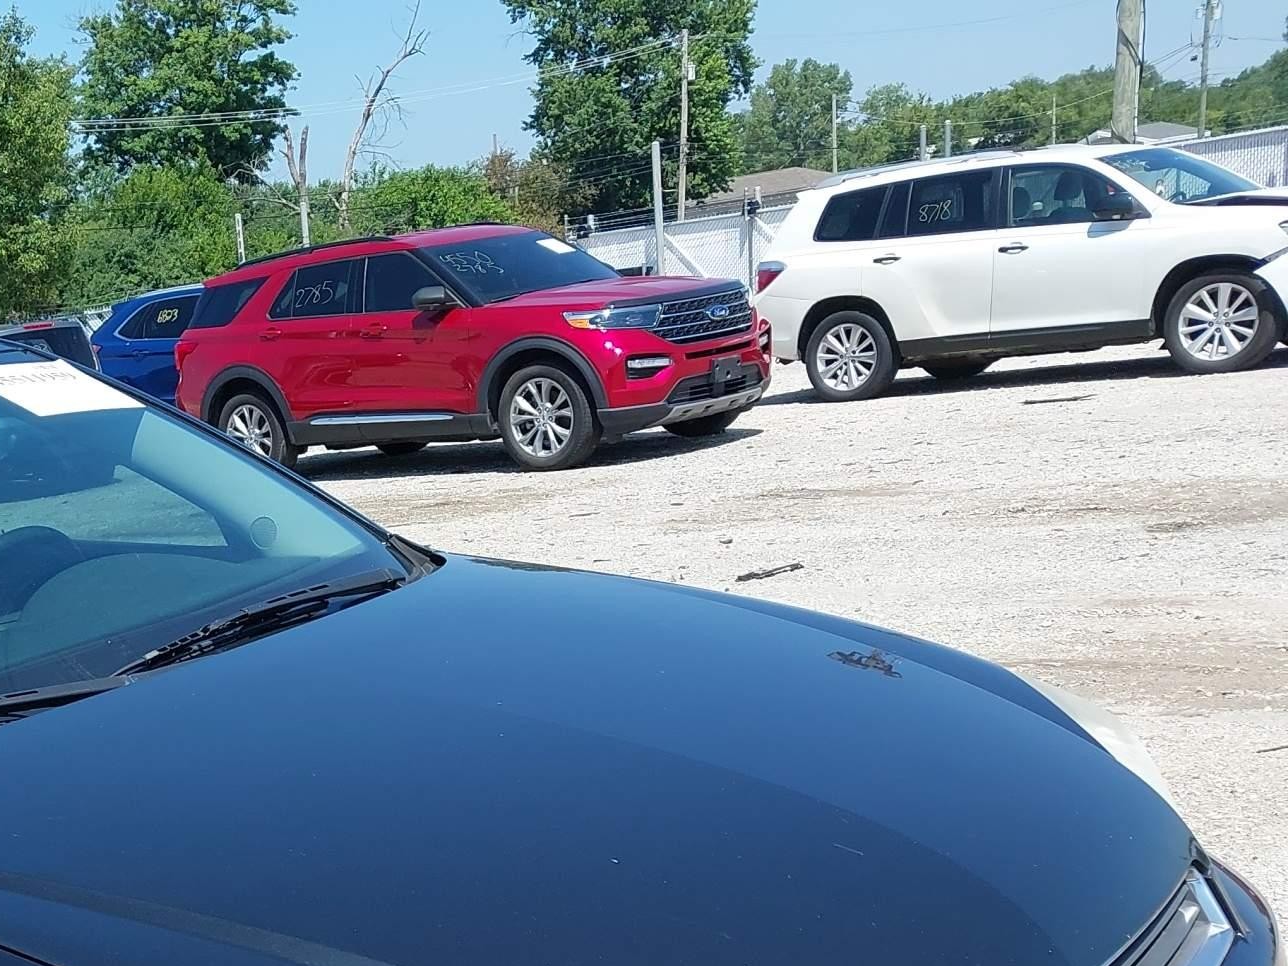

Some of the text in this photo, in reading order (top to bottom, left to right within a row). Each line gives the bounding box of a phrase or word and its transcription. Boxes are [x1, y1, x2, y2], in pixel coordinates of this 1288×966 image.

[918, 199, 952, 223] 8718
[453, 262, 505, 275] 2785
[295, 280, 334, 308] 2785
